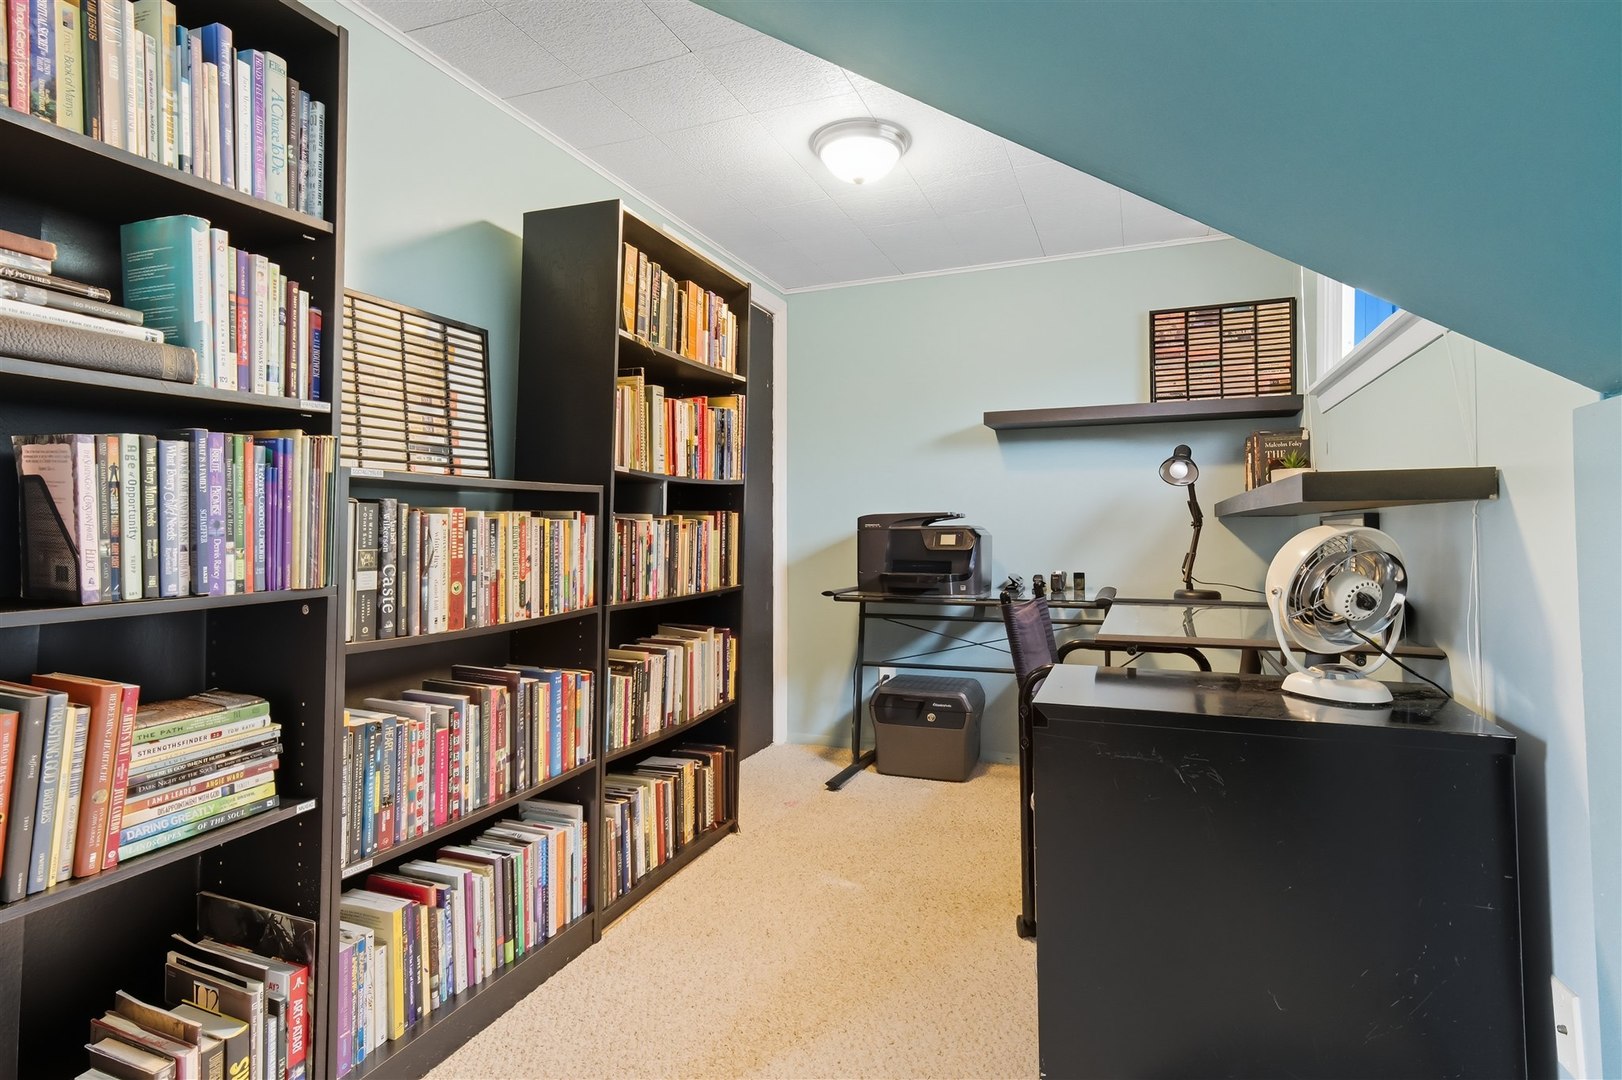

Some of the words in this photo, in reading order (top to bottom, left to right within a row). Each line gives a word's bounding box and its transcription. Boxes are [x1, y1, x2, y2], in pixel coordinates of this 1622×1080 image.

[87, 12, 97, 41] JESUS
[64, 55, 75, 76] Book
[64, 77, 75, 88] of
[255, 83, 264, 102] FEET
[62, 88, 75, 118] Martyrs
[271, 89, 284, 102] A
[255, 115, 264, 134] HIGH
[270, 103, 284, 143] Chance
[255, 135, 264, 162] PLACES
[270, 143, 284, 157] To
[270, 156, 284, 175] Die
[15, 271, 51, 284] PICTURES
[49, 315, 68, 324] STORIES
[85, 304, 132, 319] PHOTOGRAPHS
[146, 447, 156, 465] What
[166, 445, 176, 466] What
[199, 437, 207, 456] WHAT
[1288, 440, 1303, 448] Foley
[125, 445, 137, 469] Age
[211, 447, 222, 473] TRIBUTE
[144, 466, 156, 484] Every
[163, 469, 176, 491] Every
[199, 468, 207, 493] FAMILY?
[144, 486, 157, 506] Mom
[163, 491, 179, 516] Child
[211, 485, 222, 516] PROMISE
[126, 479, 137, 540] Opportunity
[146, 507, 156, 527] Needs
[166, 517, 177, 541] Needs
[382, 512, 391, 553] Wilkerson
[389, 519, 397, 545] Isabel
[85, 548, 96, 571] ELLIOT
[213, 538, 222, 559] Dennis
[212, 559, 222, 579] Rainey
[382, 563, 397, 614] Caste
[104, 692, 117, 738] REDEEMING
[121, 713, 134, 741] ARTIST'S
[46, 704, 64, 759] TRUSTING
[136, 732, 156, 741] THE
[160, 726, 184, 736] PATH
[137, 735, 208, 758] STRENGTHSFINDER
[227, 727, 239, 735] TOM
[242, 723, 256, 731] RATH
[384, 726, 394, 753] HEART
[1, 743, 10, 765] ROAD
[119, 741, 130, 756] WAY
[26, 754, 37, 779] Suffering
[43, 760, 57, 784] GOD
[98, 739, 111, 783] HEARTACHE
[146, 769, 167, 780] WHERE
[173, 764, 187, 772] GOD
[186, 759, 201, 768] WHEN
[209, 753, 226, 762] HURTS
[138, 782, 156, 793] DARK
[157, 777, 177, 787] NIGHT
[151, 796, 163, 805] AM
[164, 794, 171, 802] A
[171, 786, 197, 800] LEADER
[205, 775, 225, 789] ANGIE
[226, 771, 245, 782] WARD
[383, 764, 391, 798] COMMUNITY
[41, 788, 56, 825] BRIDGES
[112, 788, 124, 805] JULIA
[157, 796, 198, 815] DISAPPOINTMENT
[197, 793, 209, 801] WITH
[209, 789, 220, 798] GOD
[109, 805, 122, 835] CAMERON
[125, 831, 182, 853] LANDSCAPES
[197, 823, 206, 831] OF
[210, 814, 226, 826] THE
[226, 809, 246, 822] SOUL
[126, 819, 170, 841] DARING
[170, 804, 216, 826] GREATLY
[292, 998, 303, 1018] ART
[291, 1024, 303, 1055] ATARI
